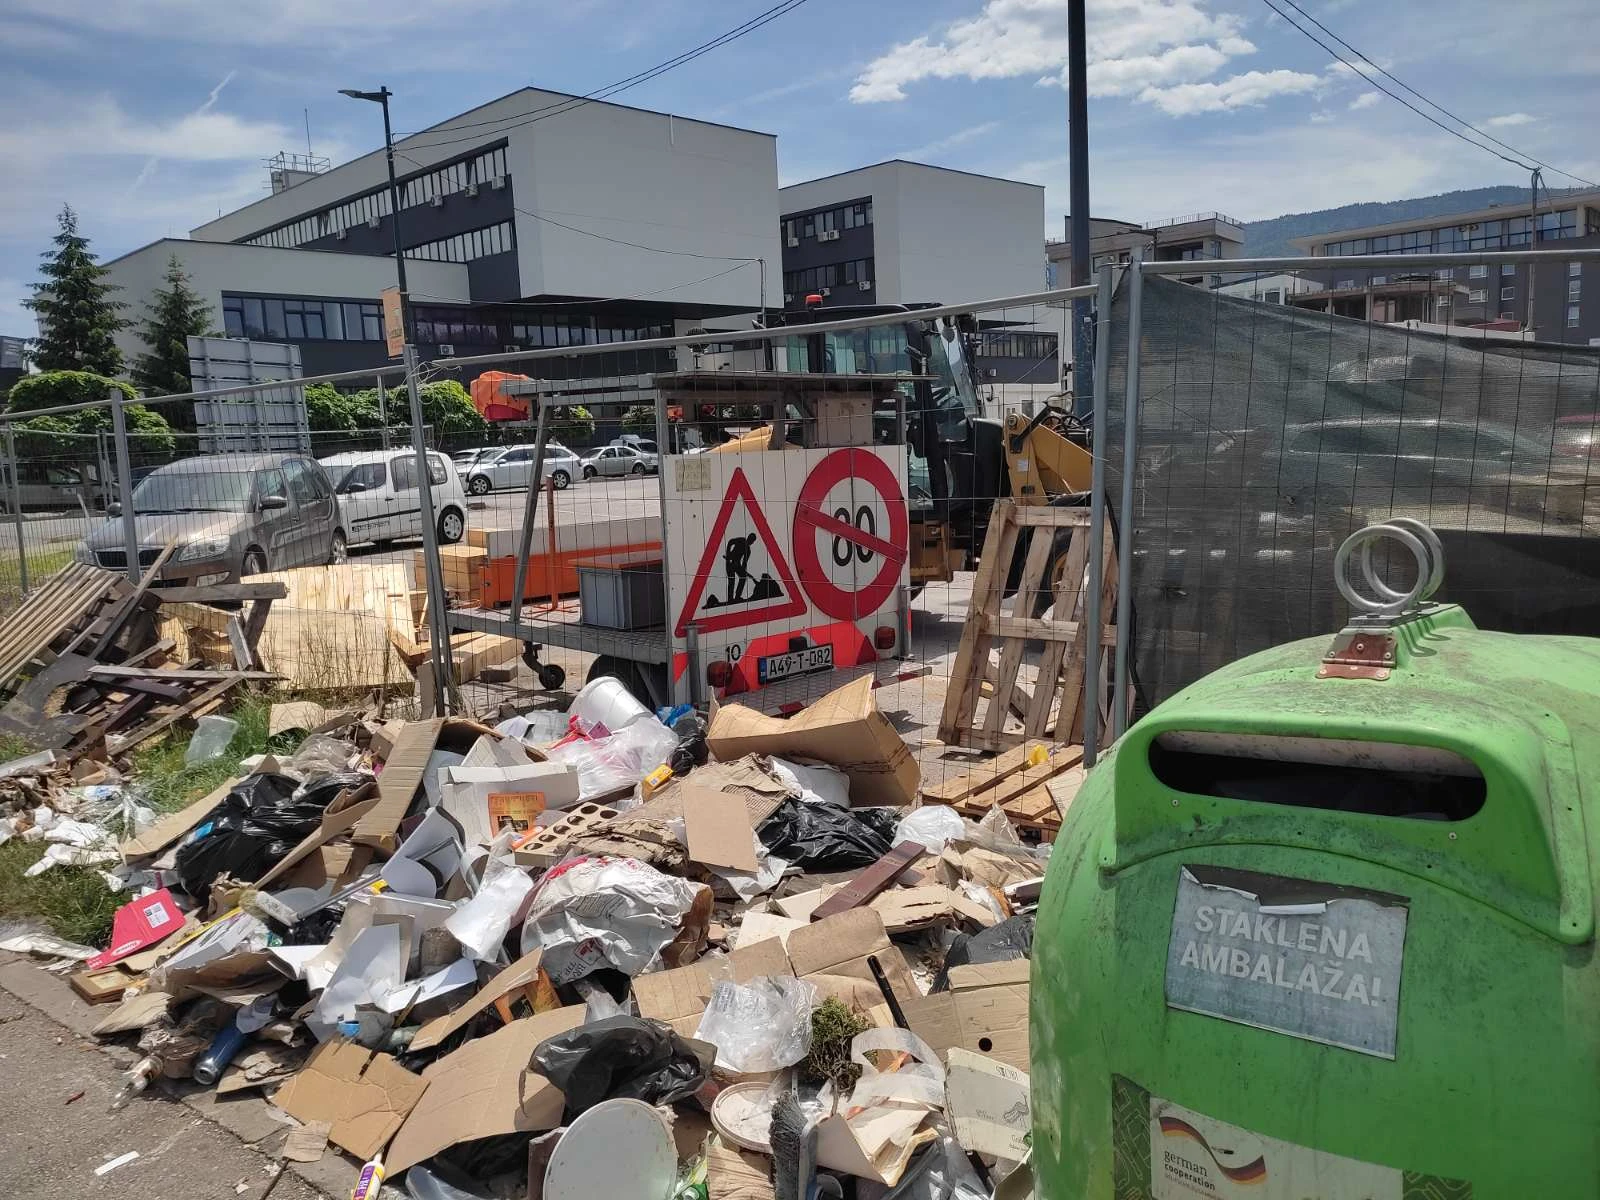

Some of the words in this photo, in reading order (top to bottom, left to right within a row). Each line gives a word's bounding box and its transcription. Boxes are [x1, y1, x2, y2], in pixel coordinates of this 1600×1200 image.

[834, 505, 875, 566] 80
[725, 644, 741, 663] 10
[1195, 906, 1373, 963] STAKLENA
[1180, 942, 1381, 1006] AMBALAŽA!
[1164, 1150, 1208, 1178] german
[1164, 1163, 1216, 1191] cooperation
